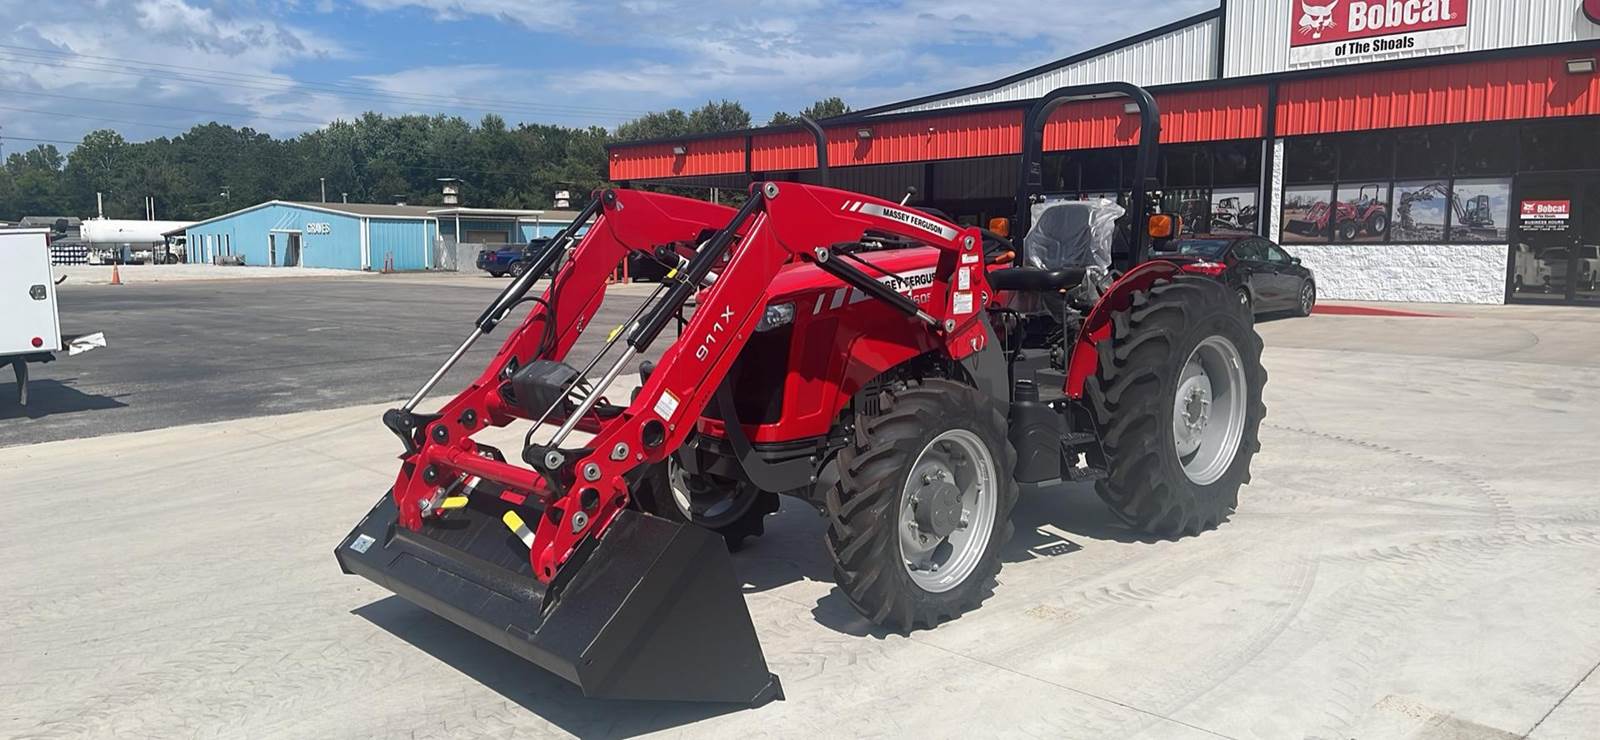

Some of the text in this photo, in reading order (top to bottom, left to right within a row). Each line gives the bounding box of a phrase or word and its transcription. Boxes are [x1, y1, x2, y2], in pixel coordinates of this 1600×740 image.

[1348, 0, 1452, 32] Bobcat
[1335, 36, 1415, 57] of The Shoals
[1537, 204, 1566, 213] Bobcat
[883, 208, 943, 235] MASSEY FERGUSON
